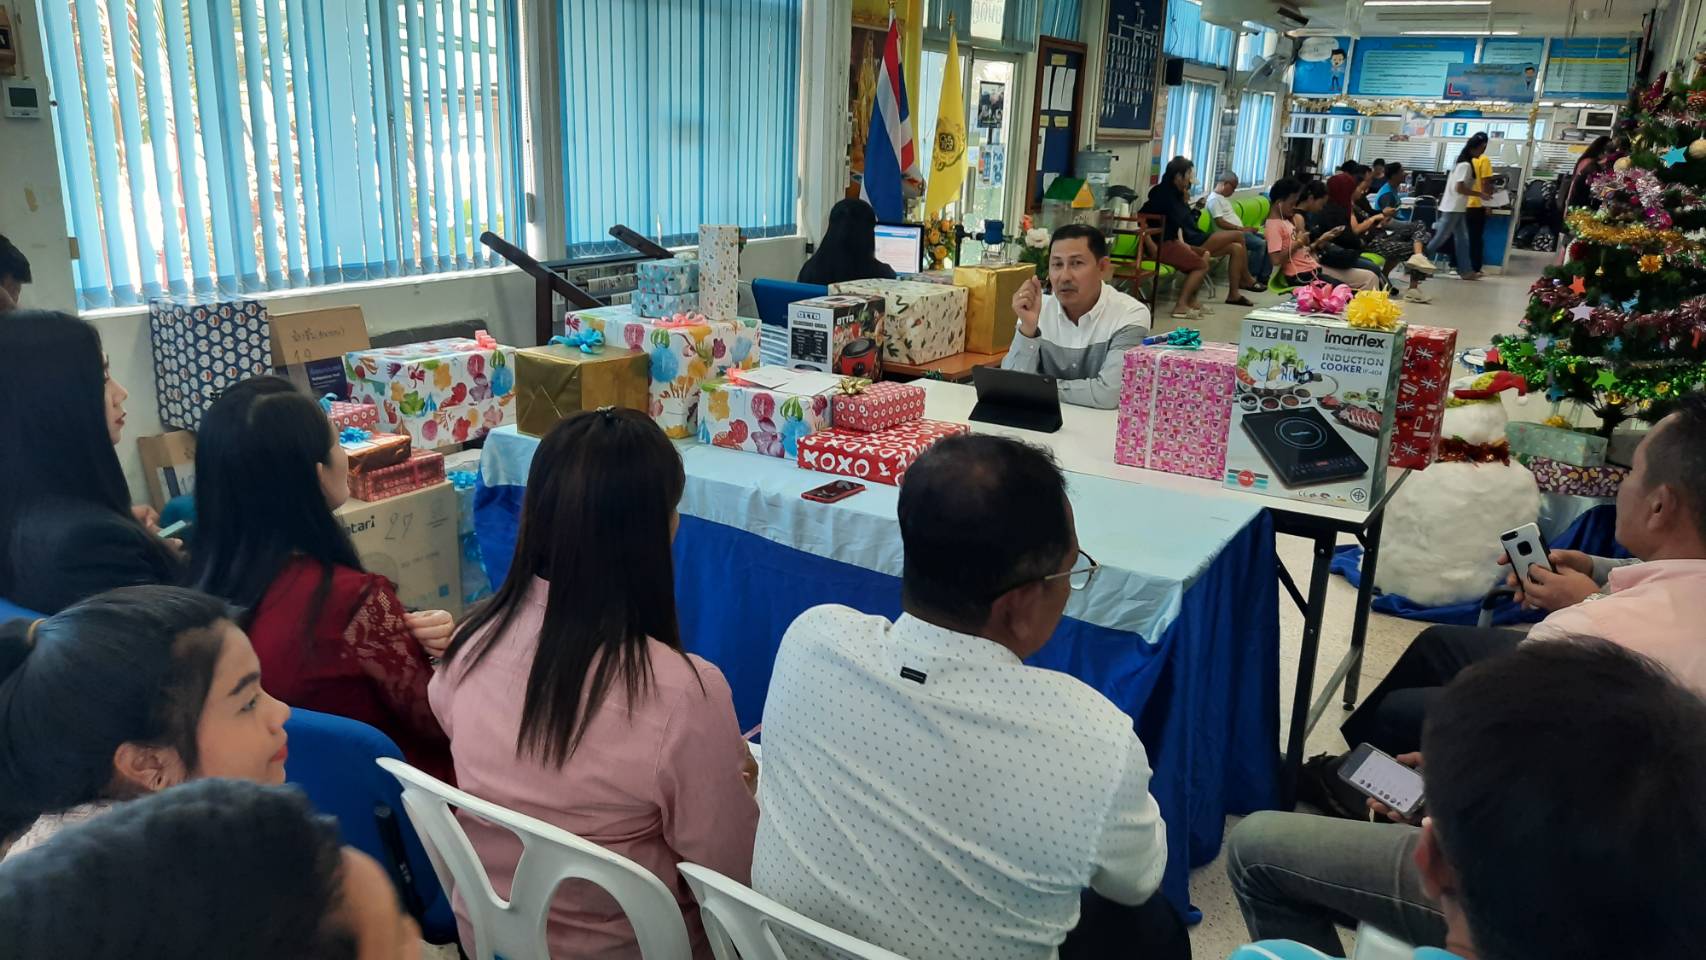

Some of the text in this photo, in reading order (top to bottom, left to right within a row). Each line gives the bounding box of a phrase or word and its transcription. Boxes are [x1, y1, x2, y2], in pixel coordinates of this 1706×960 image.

[836, 315, 855, 326] OTTO
[1324, 329, 1385, 348] imarflex
[1321, 352, 1385, 367] INDUCTION
[1320, 361, 1362, 374] COOKER
